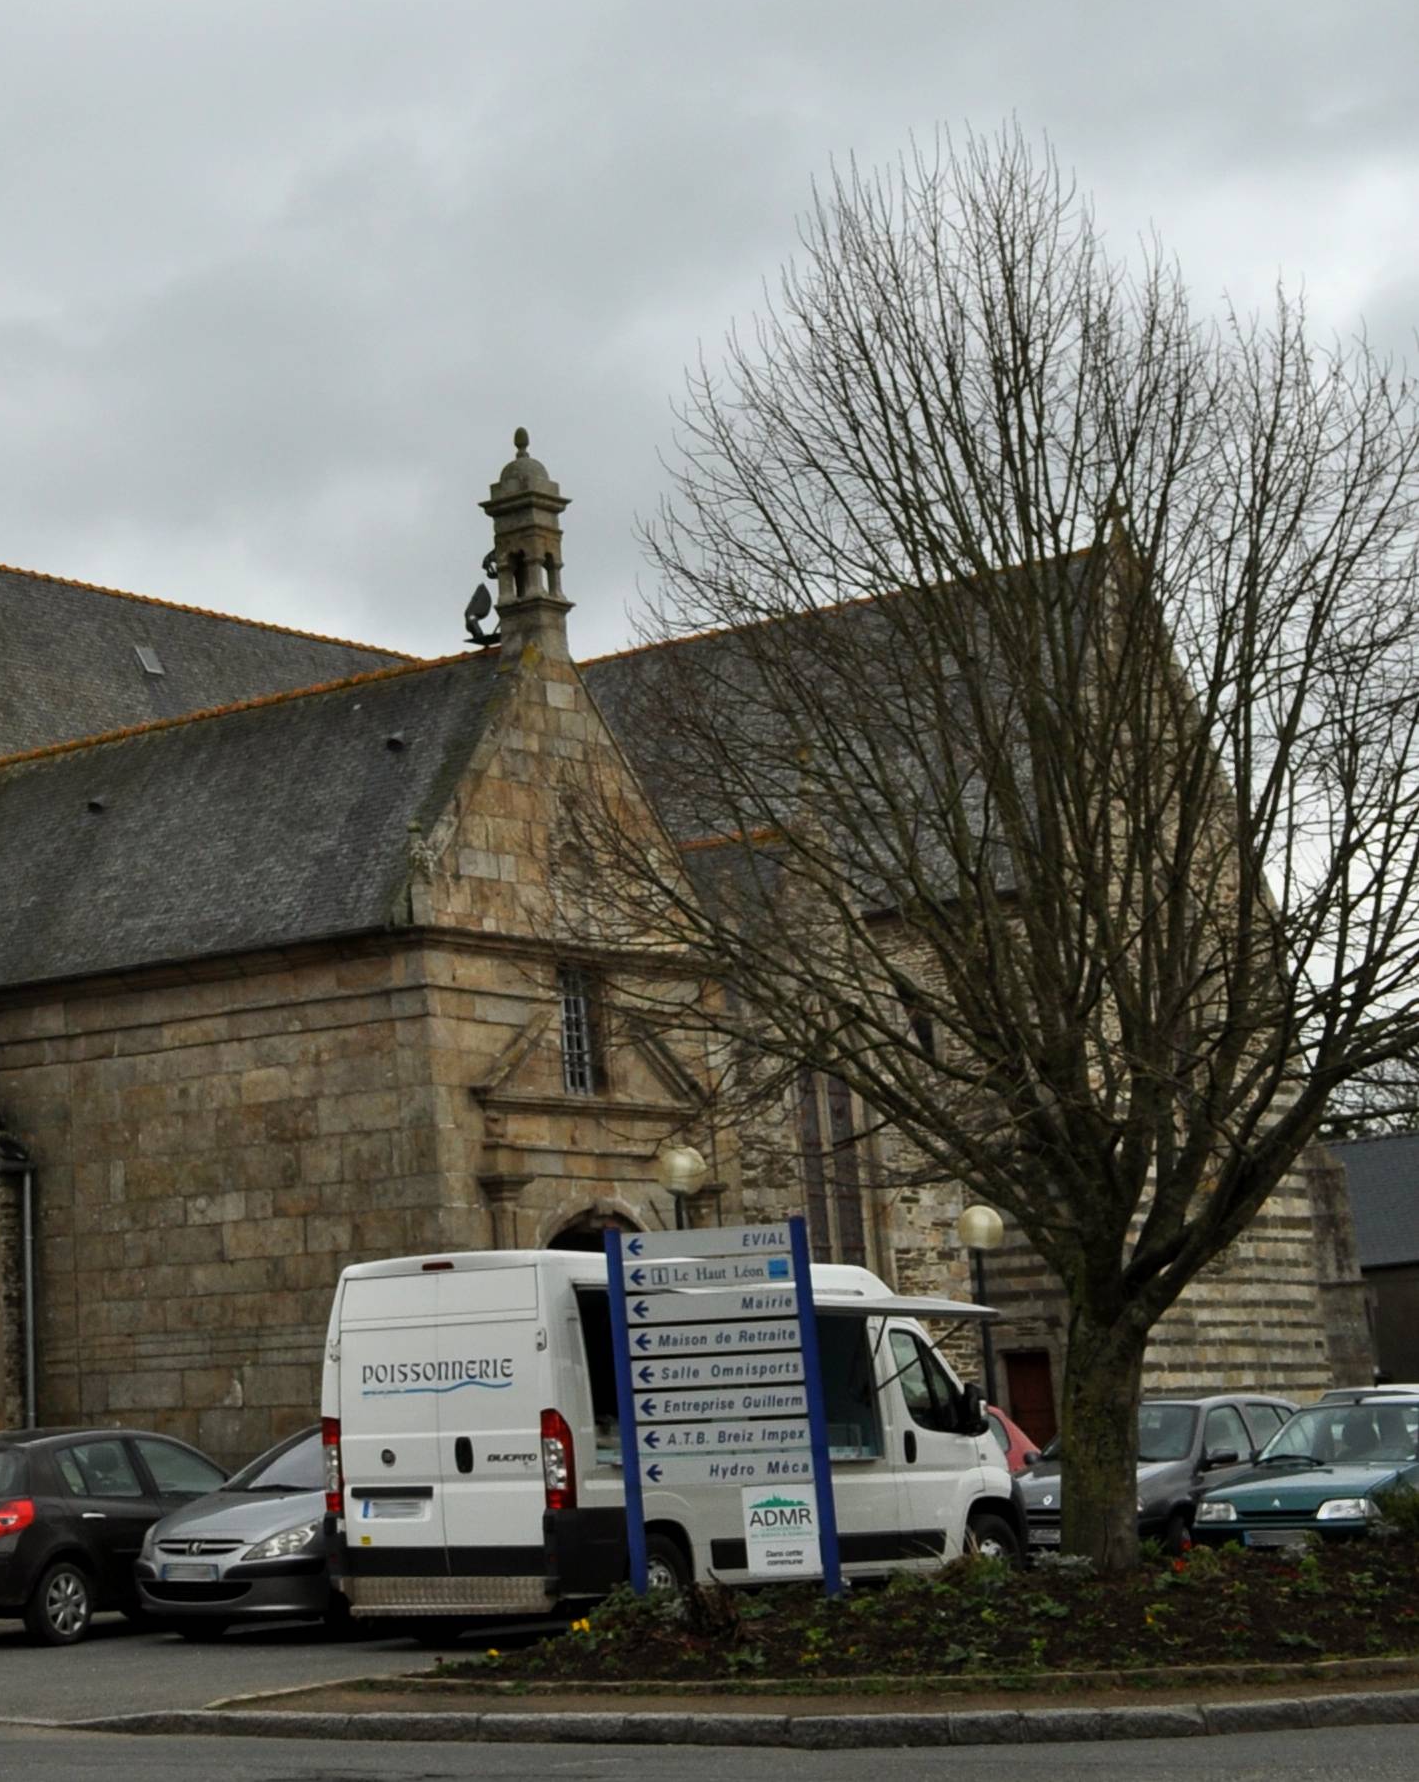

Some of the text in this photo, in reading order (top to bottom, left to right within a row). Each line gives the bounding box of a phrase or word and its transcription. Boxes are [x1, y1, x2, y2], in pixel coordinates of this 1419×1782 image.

[743, 1233, 785, 1247] EVIAL
[696, 1267, 726, 1280] Haut
[735, 1265, 764, 1278] Léon
[741, 1296, 792, 1310] Mairie
[658, 1329, 796, 1347] Maison de Retraite
[362, 1358, 513, 1384] POISSONNERIE
[662, 1361, 799, 1380] Salle Omnisports
[664, 1394, 803, 1414] Entreprise Guillerm
[667, 1428, 805, 1446] A.T.B. Breiz Impex
[710, 1460, 810, 1480] Hydro Méca
[750, 1508, 813, 1527] ADMR
